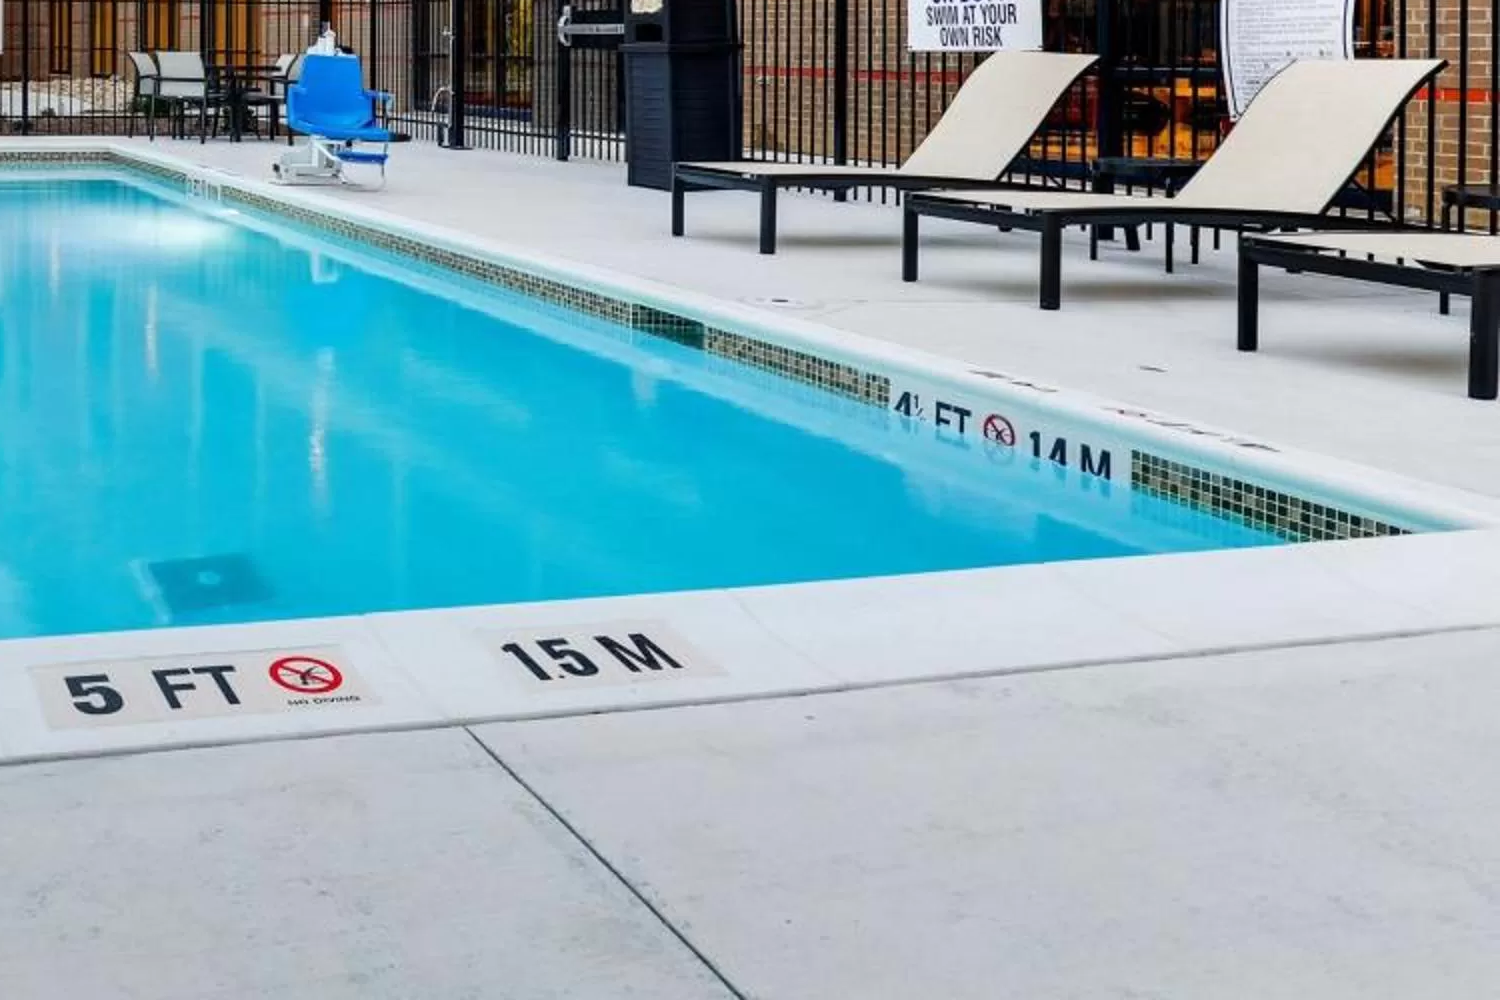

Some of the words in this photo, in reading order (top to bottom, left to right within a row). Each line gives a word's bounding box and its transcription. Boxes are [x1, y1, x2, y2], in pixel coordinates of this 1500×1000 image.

[926, 5, 959, 26] SWIM
[963, 4, 976, 25] AT
[980, 3, 1017, 25] YOUR
[940, 26, 969, 47] OWN
[971, 25, 1003, 47] RISK
[935, 401, 971, 434] FT
[1080, 444, 1112, 481] M
[593, 633, 683, 673] M
[64, 674, 125, 715] 5
[152, 665, 242, 710] FT
